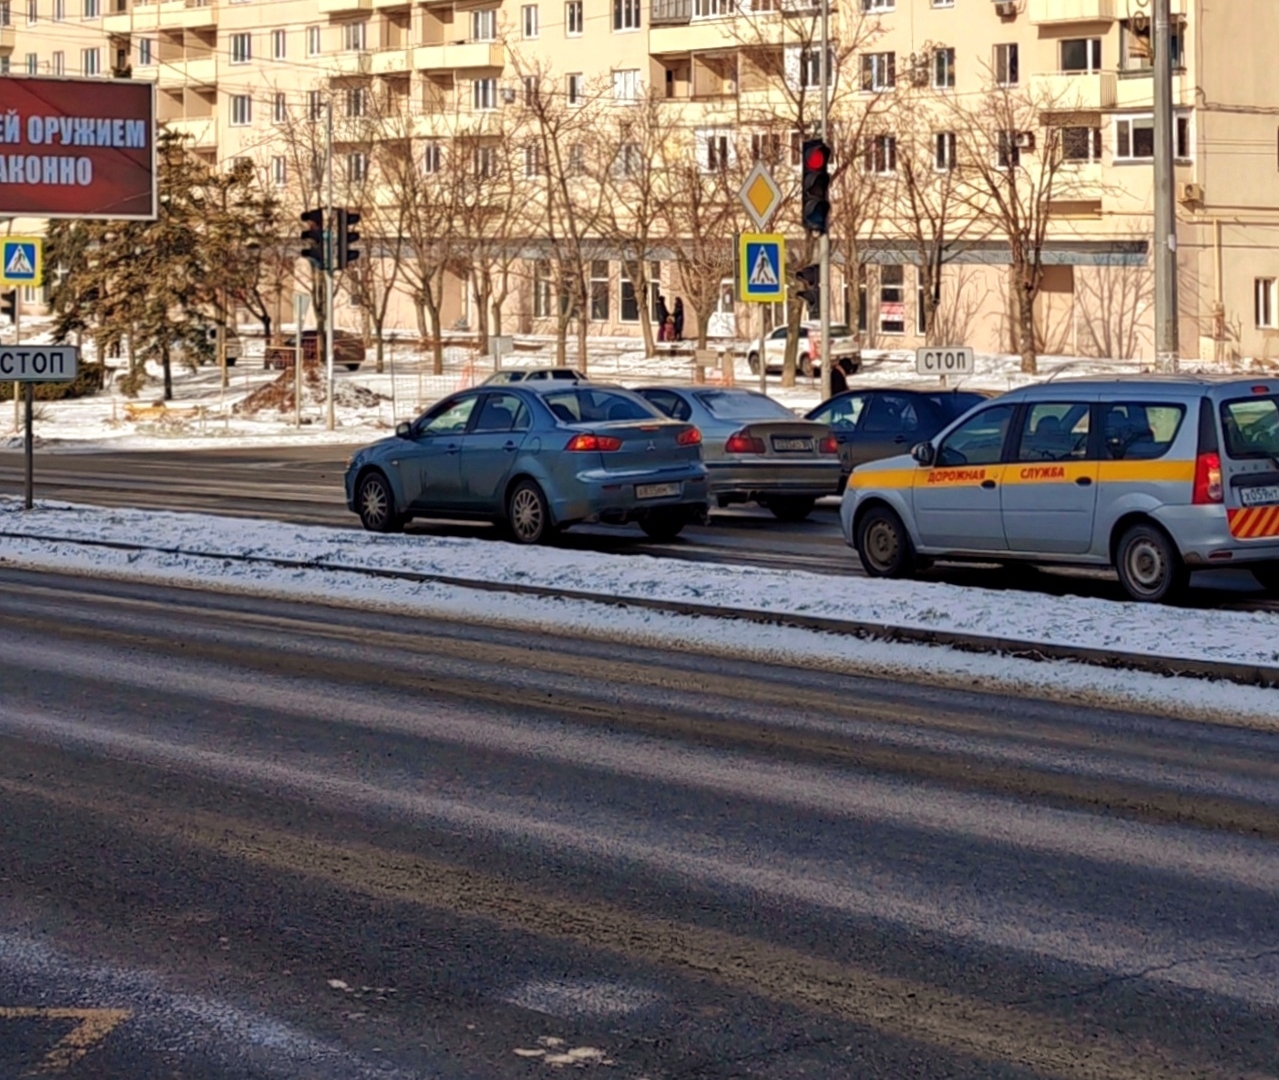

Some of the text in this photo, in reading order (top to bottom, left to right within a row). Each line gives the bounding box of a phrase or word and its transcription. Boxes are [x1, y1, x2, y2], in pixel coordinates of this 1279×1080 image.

[27, 115, 145, 148] ОРУЖИЕМ
[0, 352, 64, 374] СТОП
[924, 352, 966, 370] СТОП
[928, 466, 1065, 484] ДОРОЖНАЯ СЛУЖБА
